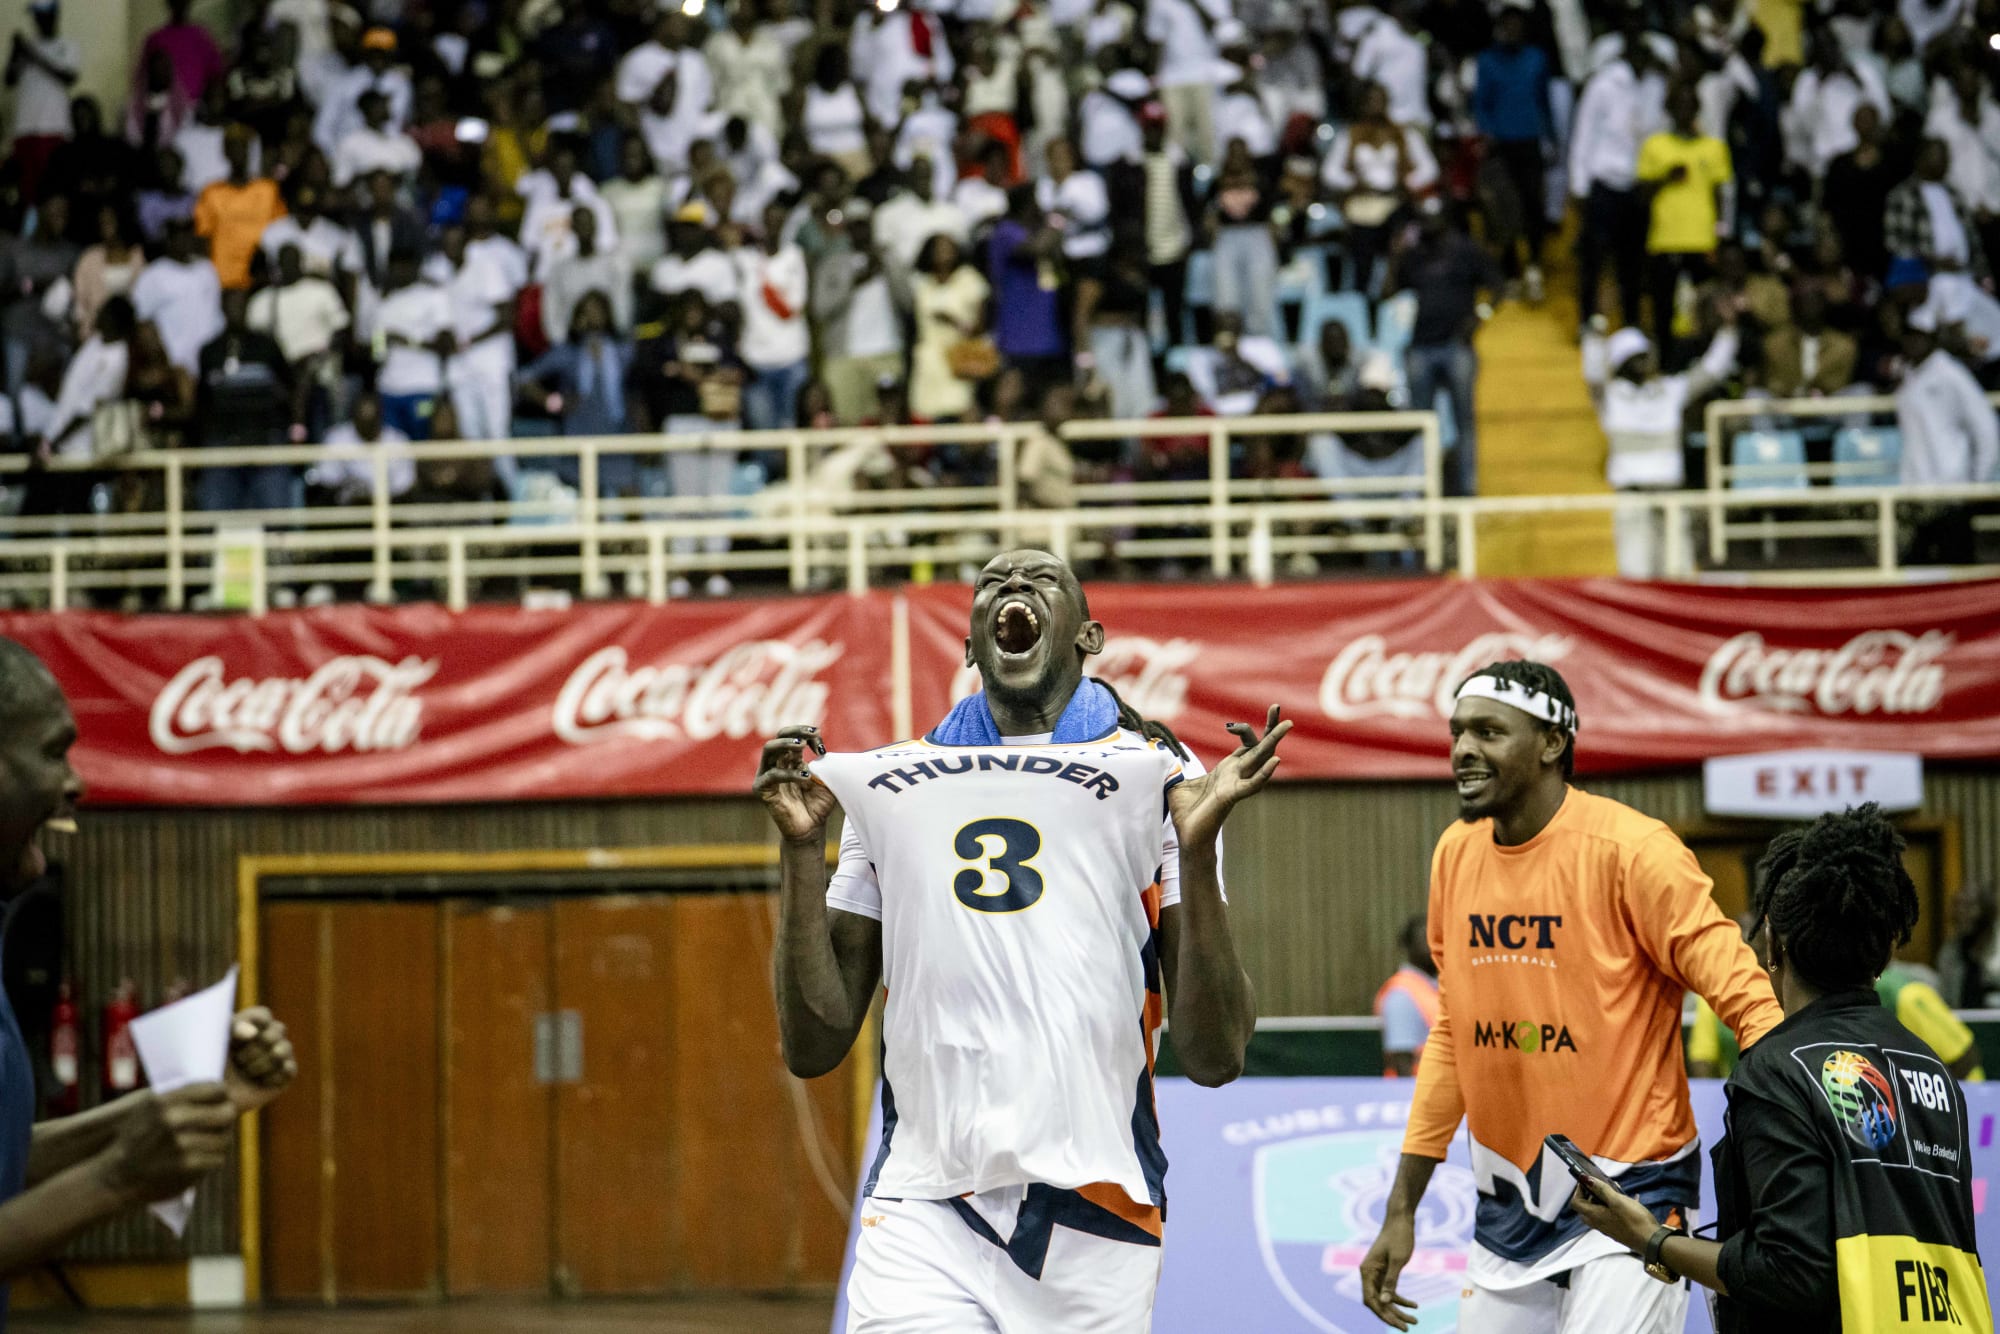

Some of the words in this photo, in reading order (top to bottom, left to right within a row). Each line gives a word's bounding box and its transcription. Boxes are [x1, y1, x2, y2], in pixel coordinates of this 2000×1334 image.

[552, 639, 846, 745] Coca-Cola
[1699, 629, 1957, 717] Coca-Cola
[148, 655, 440, 755] Coca-Cola
[867, 753, 1120, 801] THUNDER
[1755, 765, 1870, 797] EXIT
[953, 816, 1044, 915] 3
[1468, 914, 1562, 949] NCT
[1471, 954, 1557, 969] BASKETBALL
[1900, 1068, 1951, 1113] FIBA
[1221, 1104, 1346, 1146] CLUBE
